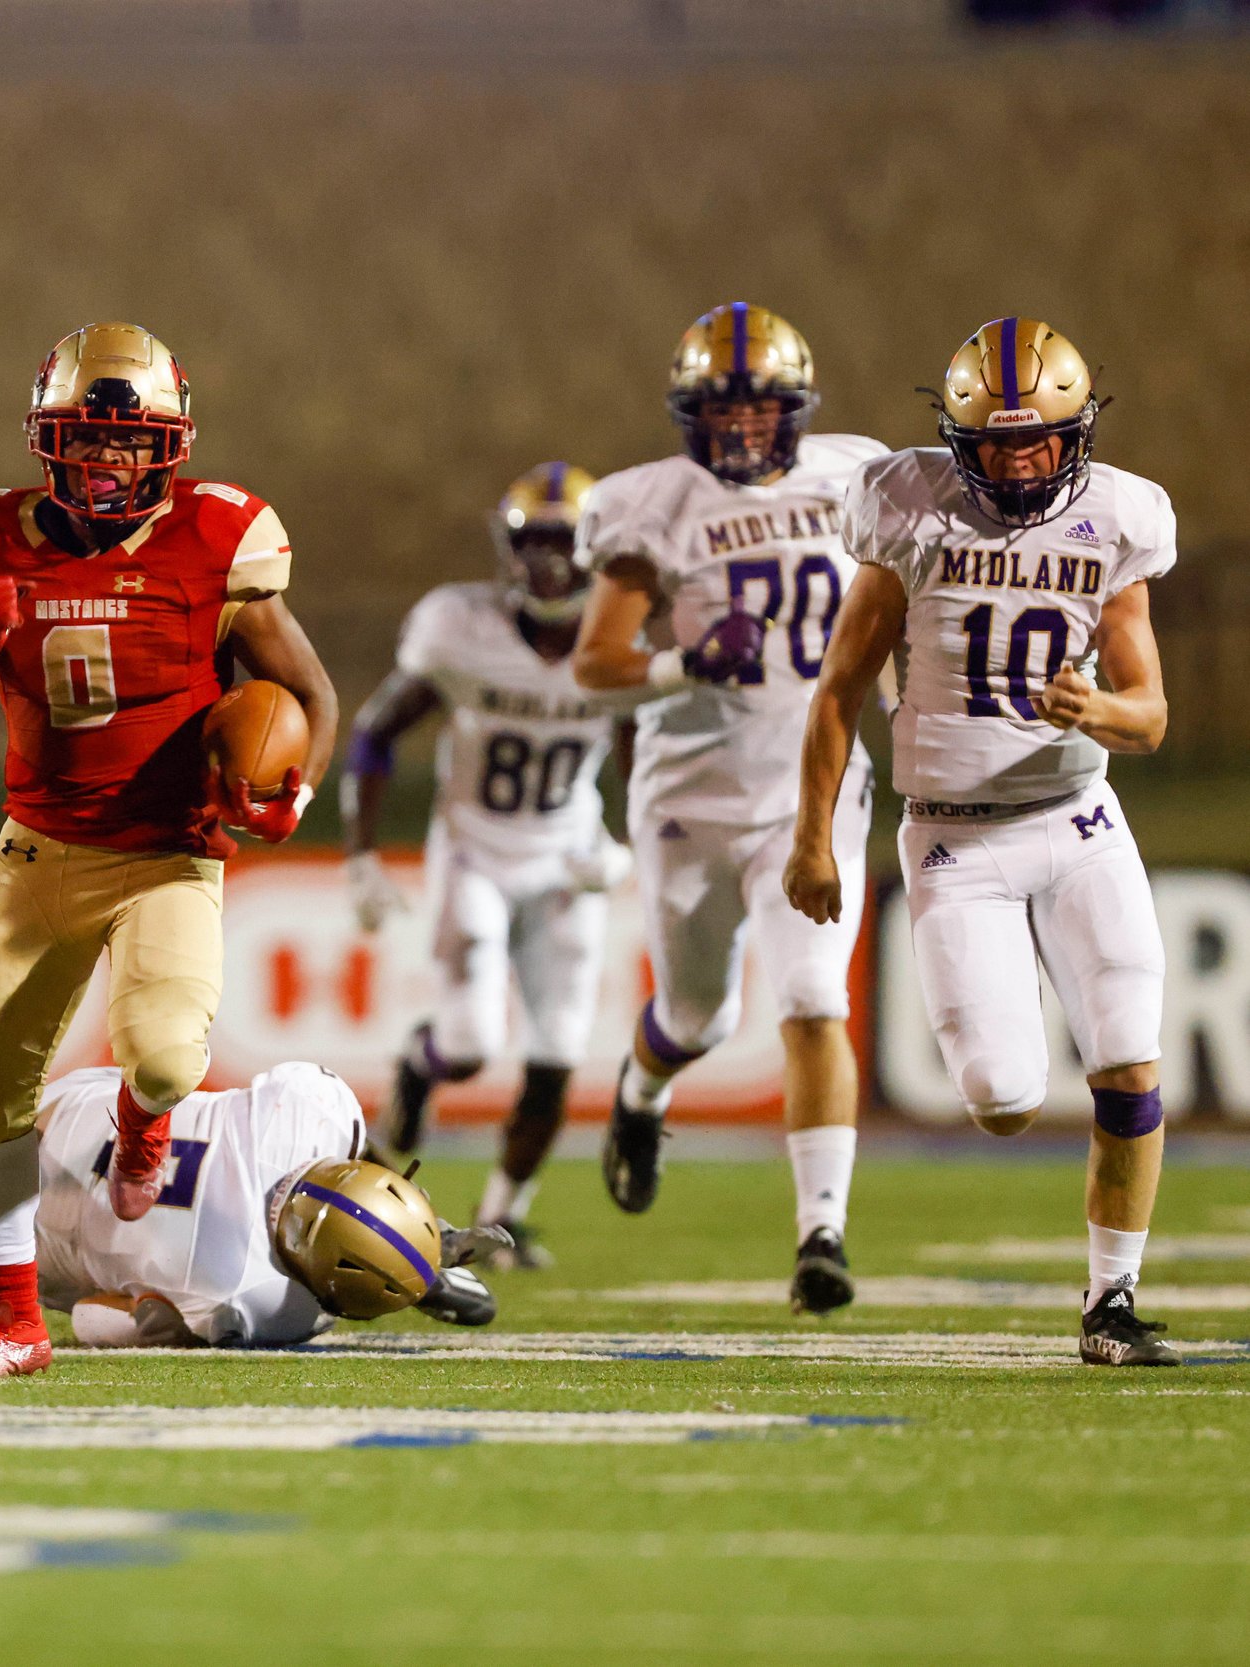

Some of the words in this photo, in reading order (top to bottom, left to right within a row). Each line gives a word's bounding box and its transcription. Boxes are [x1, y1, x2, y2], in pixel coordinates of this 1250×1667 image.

[994, 413, 1034, 423] Riddell
[1065, 530, 1100, 543] adidas
[939, 548, 1104, 596] MIDLAND
[35, 599, 128, 619] MUSTANGS
[727, 554, 842, 687] 70
[41, 624, 118, 728] 0
[960, 602, 1070, 722] 10
[478, 728, 587, 814] 80
[1070, 803, 1115, 841] M
[921, 857, 957, 869] adidas
